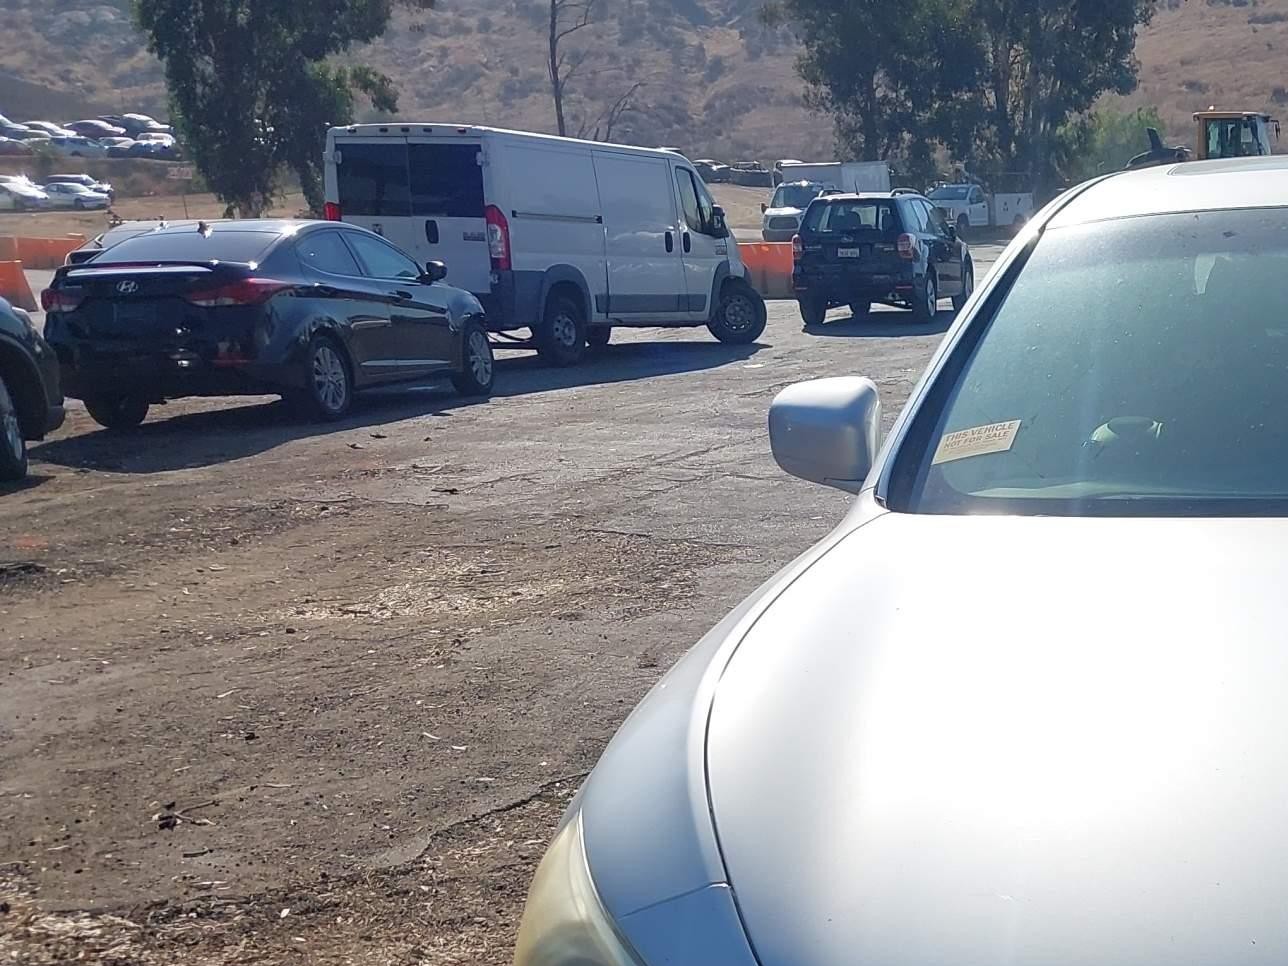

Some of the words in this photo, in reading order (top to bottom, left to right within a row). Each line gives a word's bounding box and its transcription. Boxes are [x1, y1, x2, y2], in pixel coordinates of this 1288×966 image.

[944, 440, 963, 449] NOT
[963, 435, 982, 444] FOR
[984, 431, 1009, 440] SALE
[946, 432, 969, 442] THIS
[970, 423, 1015, 434] VEHICLE
